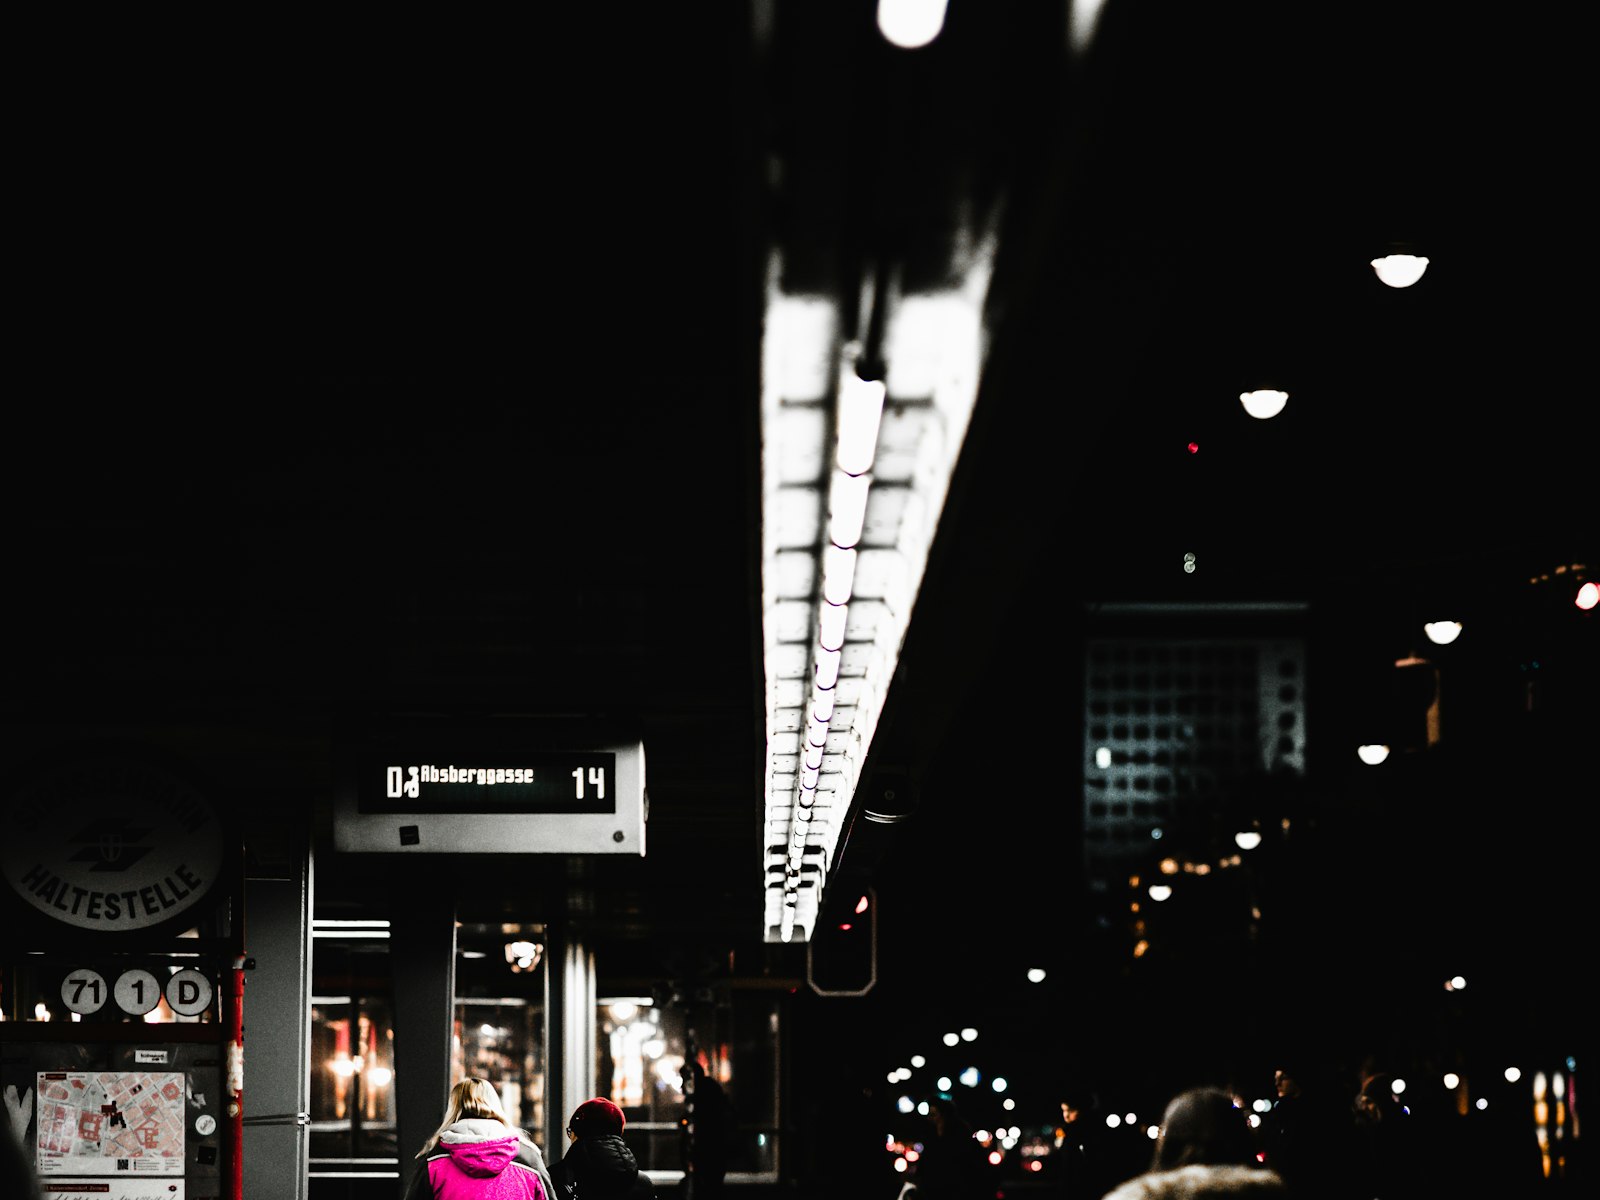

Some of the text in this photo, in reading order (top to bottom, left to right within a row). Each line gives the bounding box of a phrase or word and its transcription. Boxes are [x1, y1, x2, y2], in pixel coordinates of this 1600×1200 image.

[12, 767, 212, 835] STRASSENBAHN
[421, 765, 534, 785] Absberggasse
[572, 767, 605, 799] 14
[21, 863, 202, 920] HALTESTELLE
[69, 979, 200, 1005] 71 1 D
